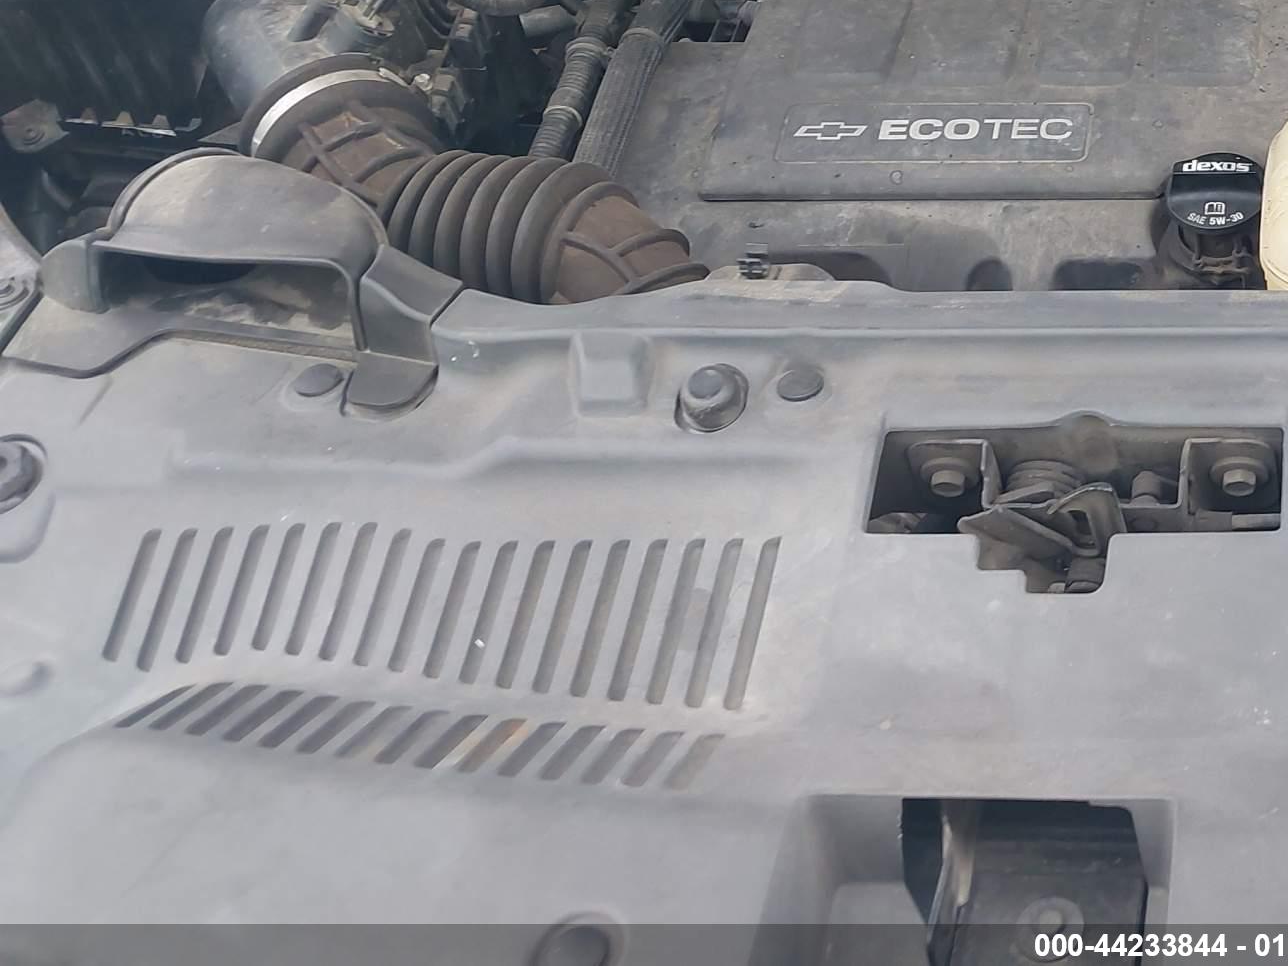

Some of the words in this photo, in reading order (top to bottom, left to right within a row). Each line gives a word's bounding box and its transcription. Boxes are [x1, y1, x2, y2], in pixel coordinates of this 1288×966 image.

[878, 118, 1073, 140] ECOTEC
[1182, 159, 1254, 172] dexos
[1187, 212, 1207, 225] SAE
[1209, 211, 1244, 226] 5W-30
